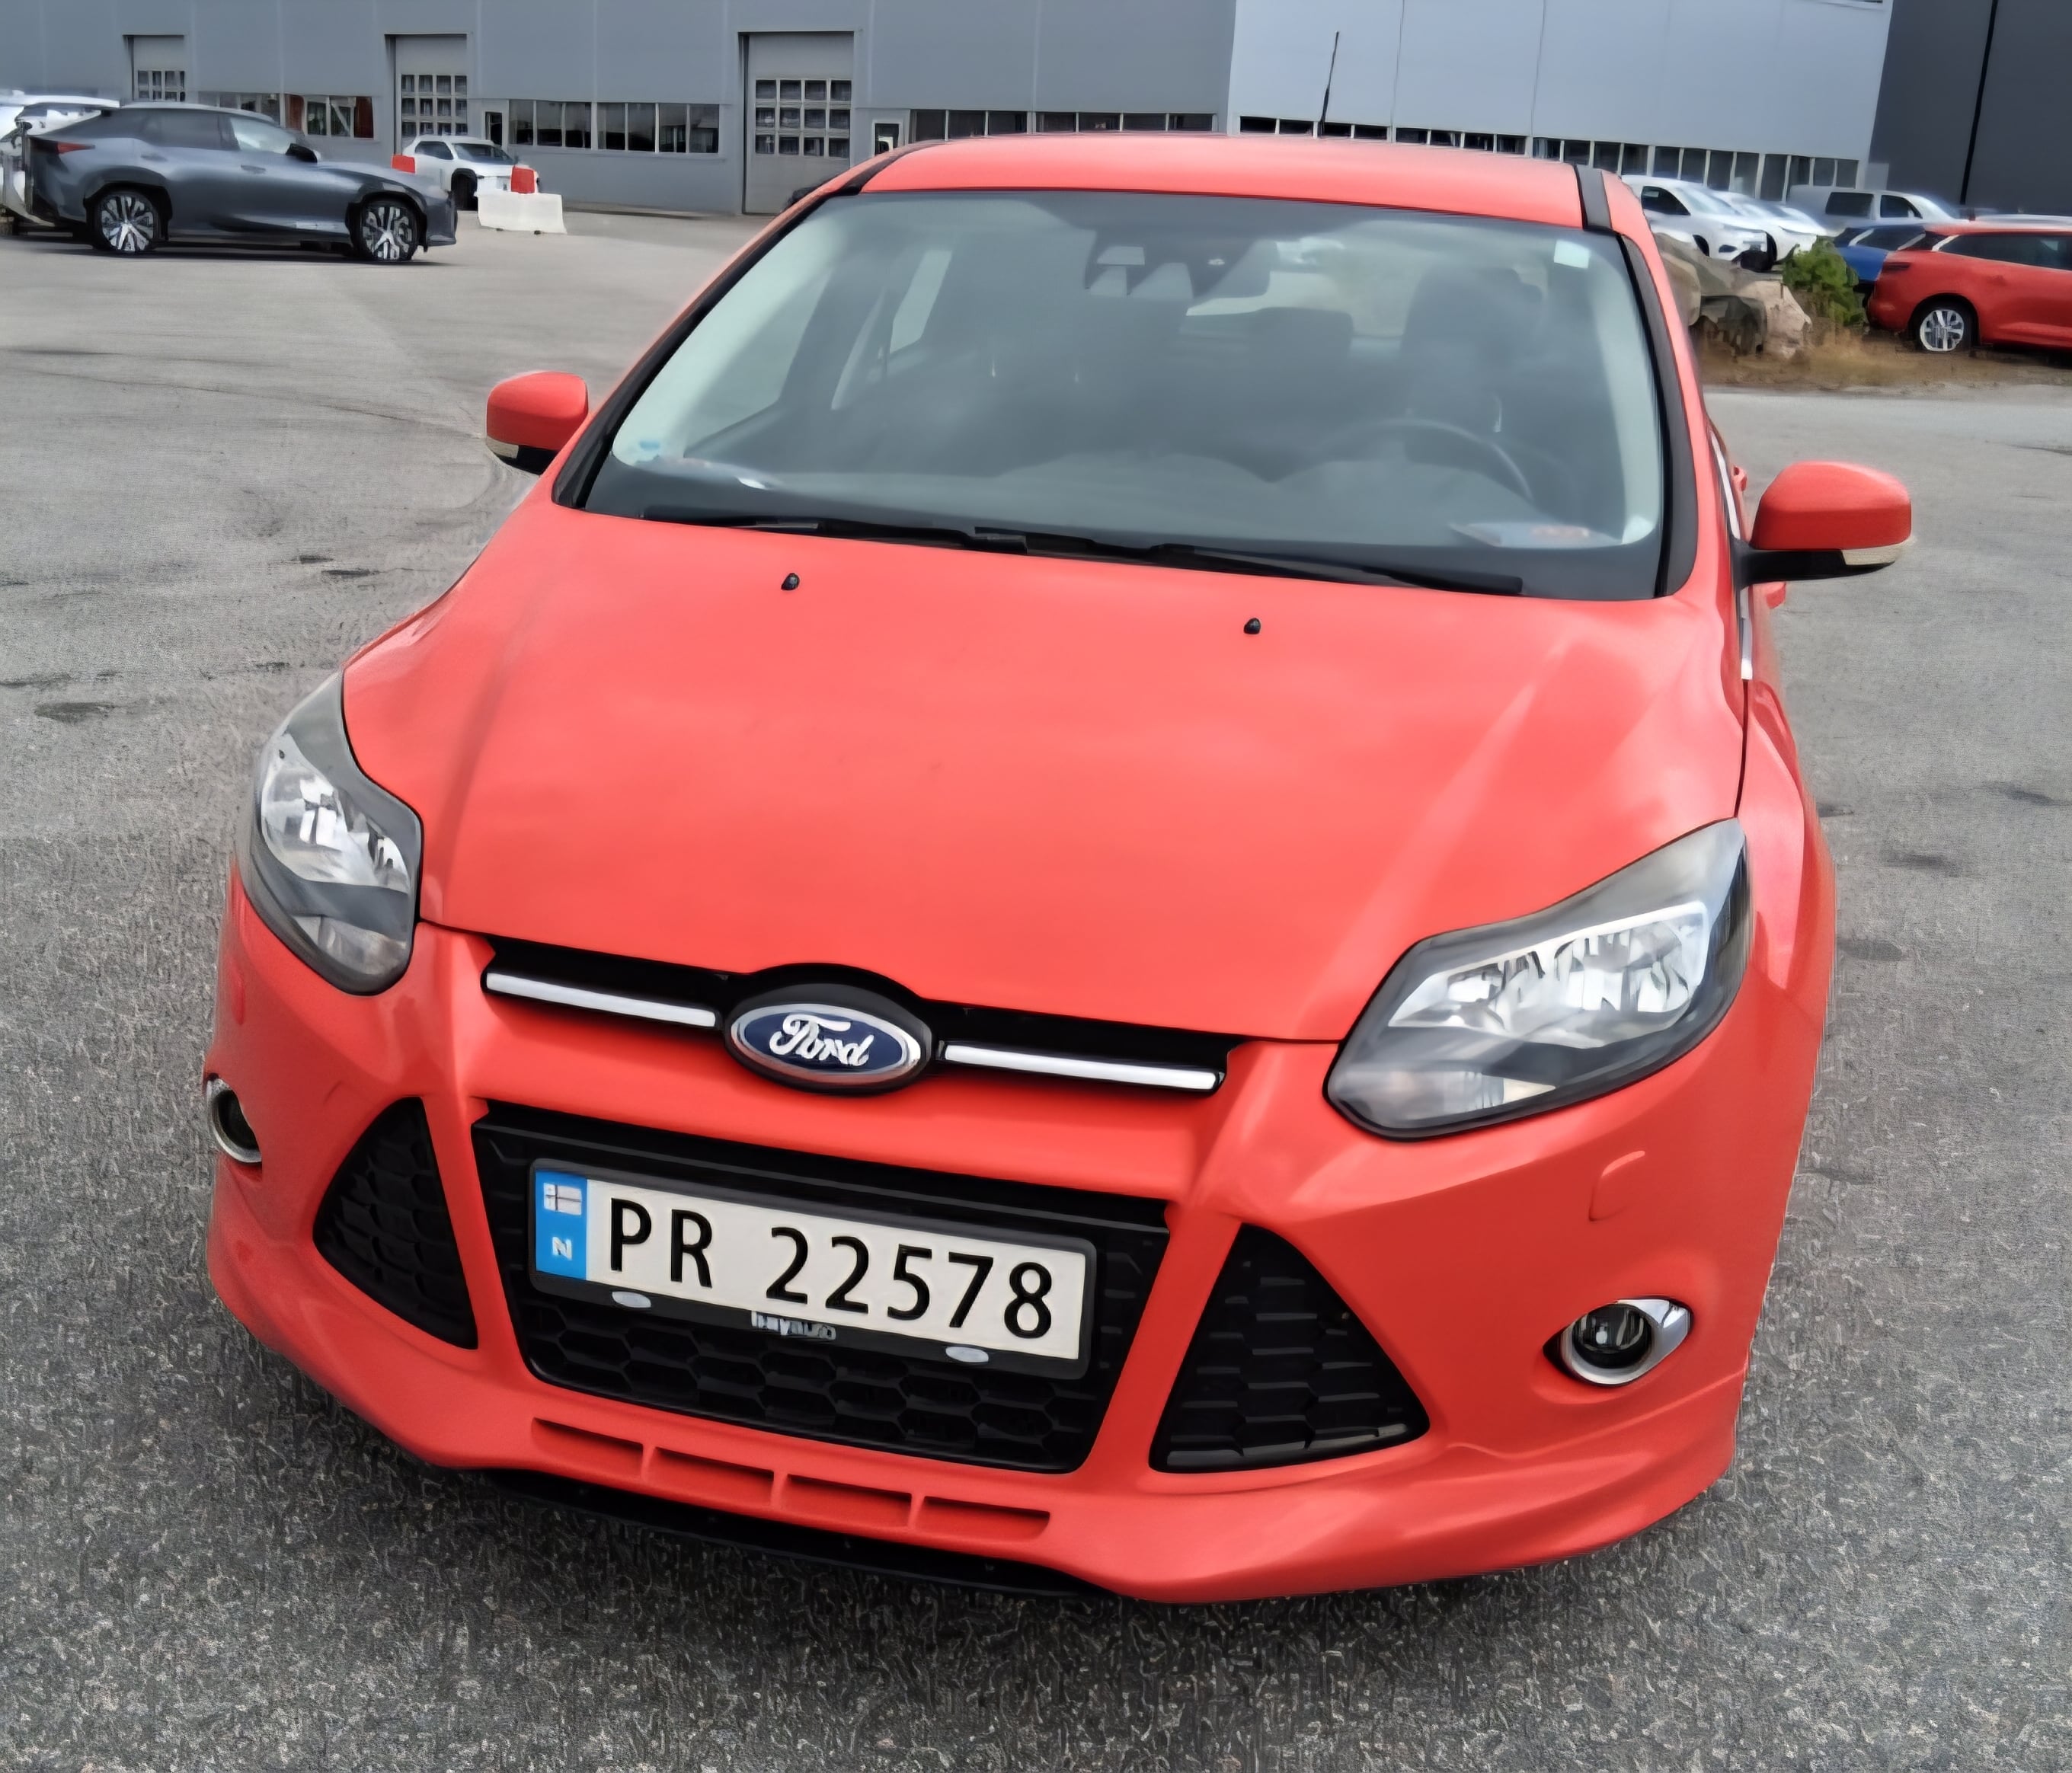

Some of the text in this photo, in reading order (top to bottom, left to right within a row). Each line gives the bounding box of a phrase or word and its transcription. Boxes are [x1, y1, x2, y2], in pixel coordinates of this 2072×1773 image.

[769, 1014, 874, 1066] Ford
[552, 1236, 572, 1260] N
[610, 1197, 1053, 1340] PR 22578
